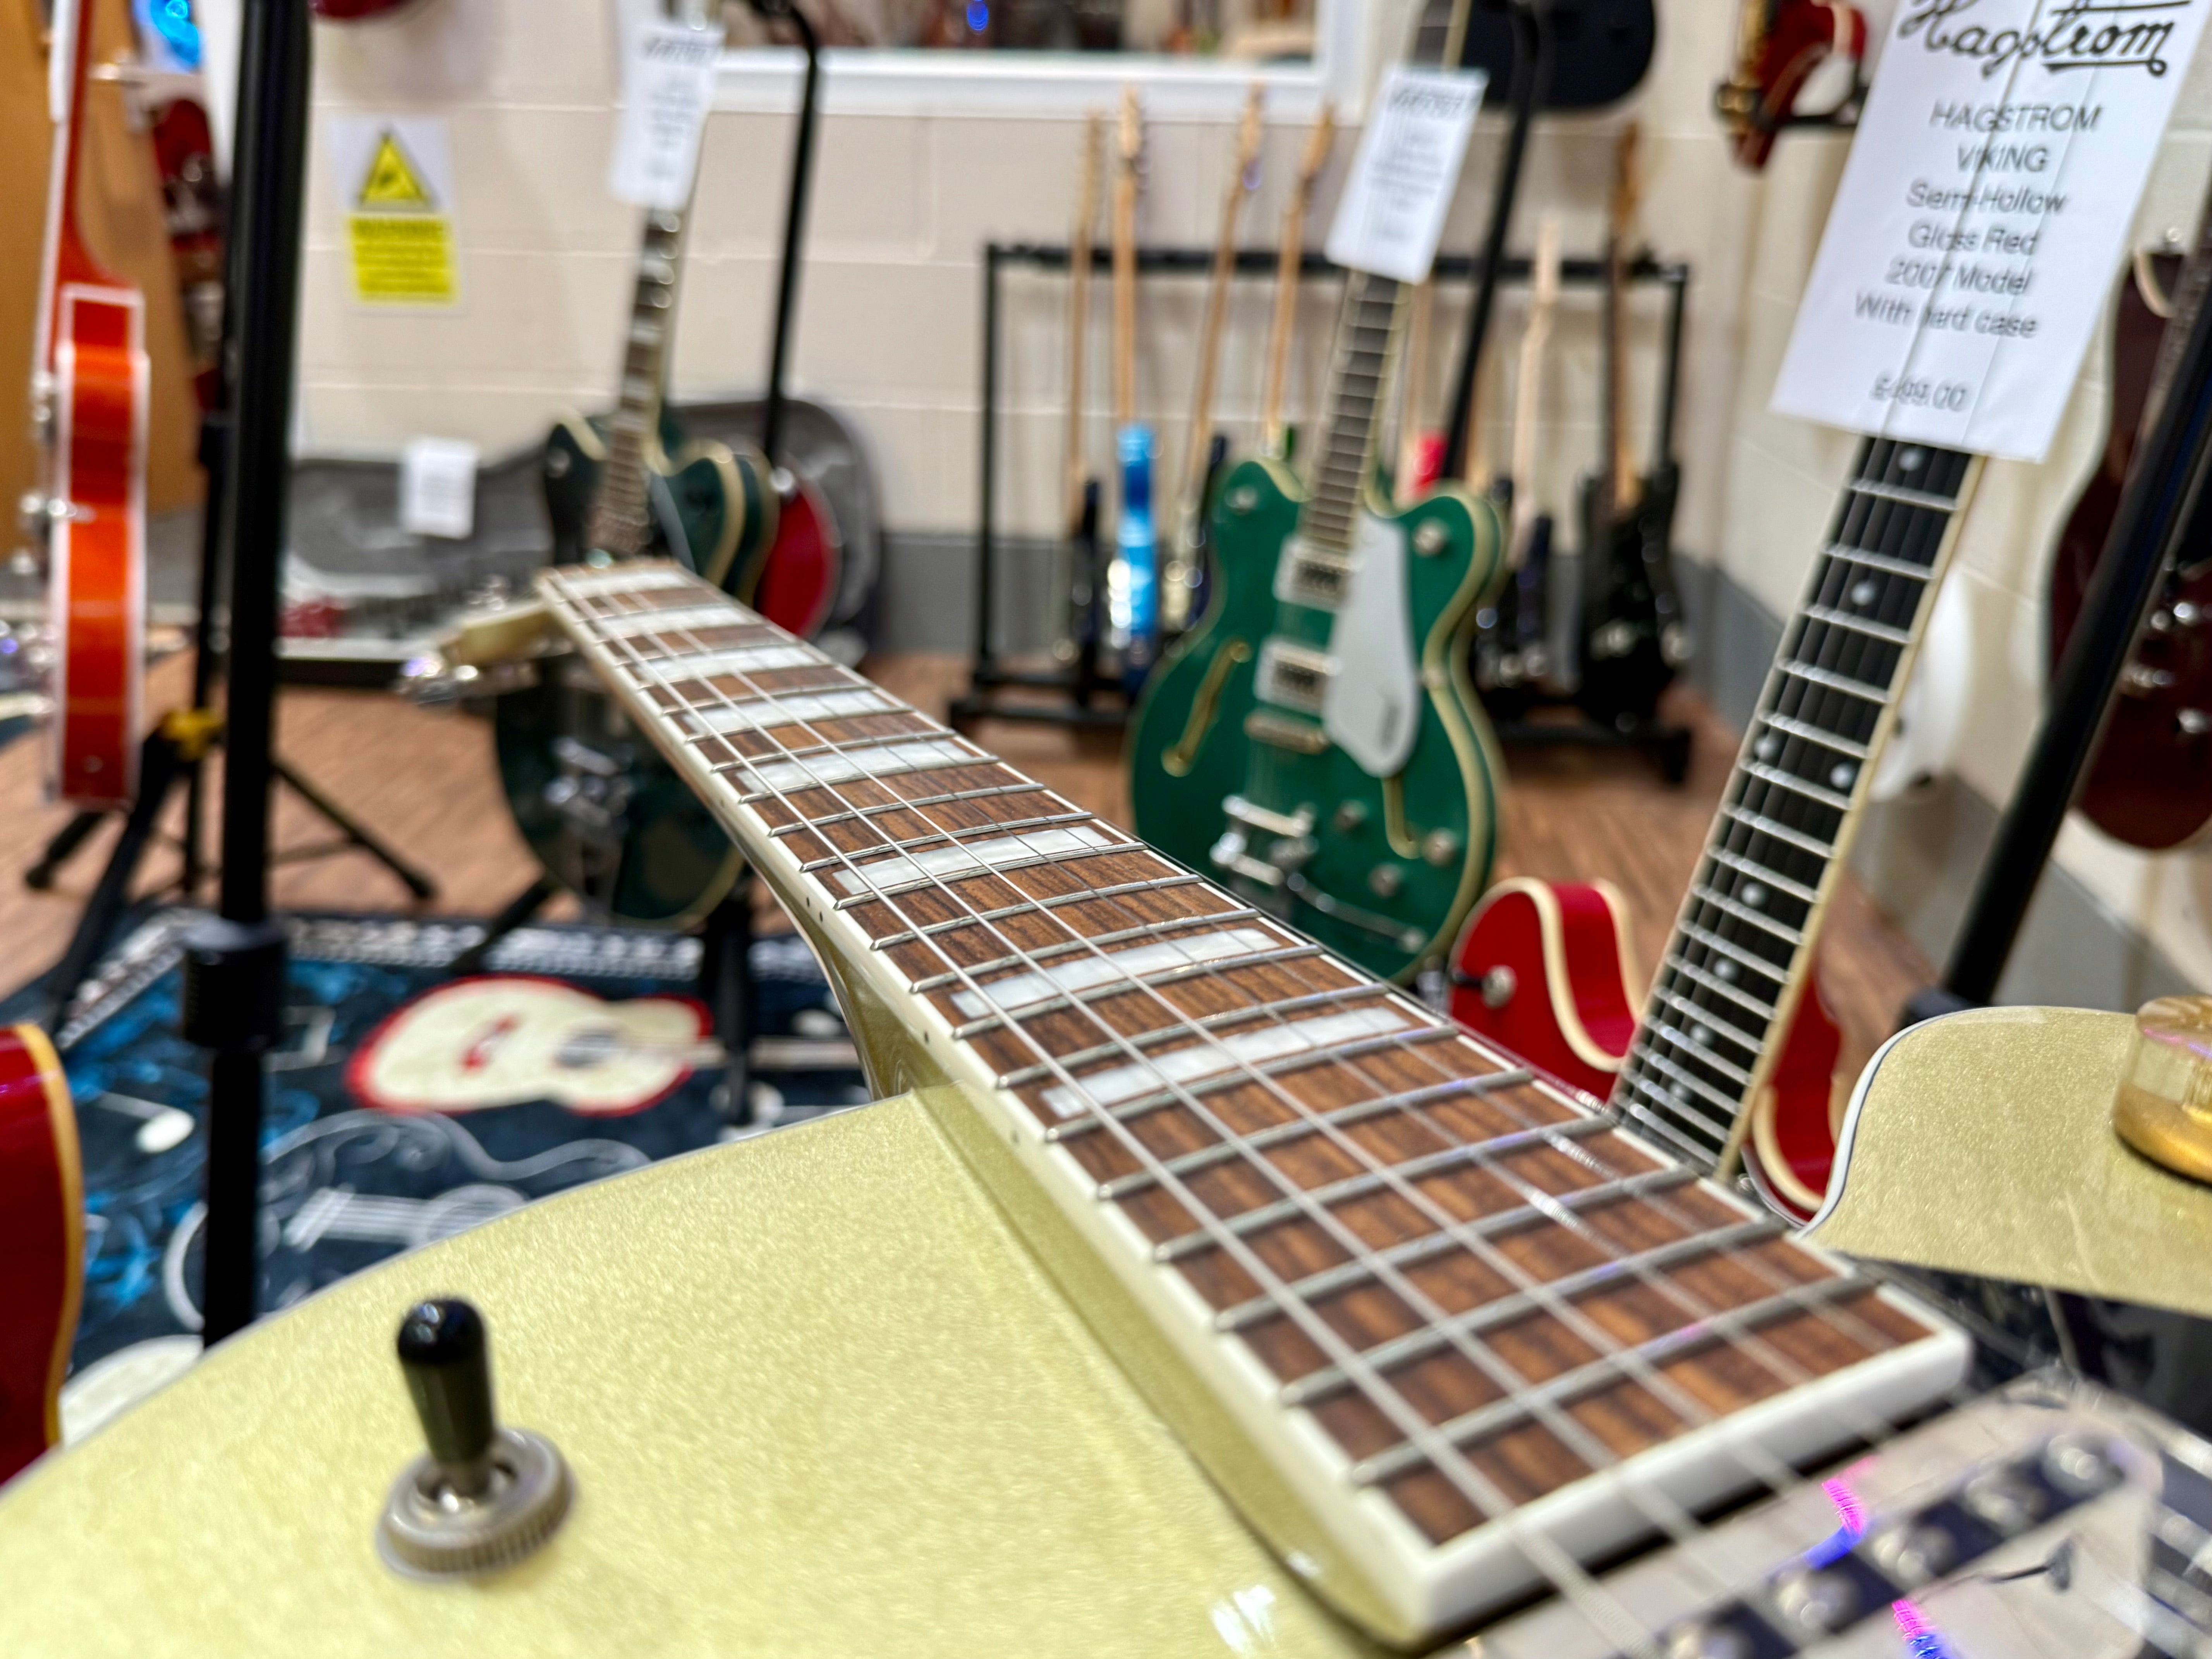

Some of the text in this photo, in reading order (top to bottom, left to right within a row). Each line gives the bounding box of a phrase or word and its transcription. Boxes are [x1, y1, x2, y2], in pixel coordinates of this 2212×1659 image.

[1930, 100, 2104, 133] HAGSTROM
[1958, 143, 2049, 173] VIKING
[1982, 222, 2039, 256] Red
[1953, 264, 2033, 296] Model
[1855, 291, 2039, 339] With ard case
